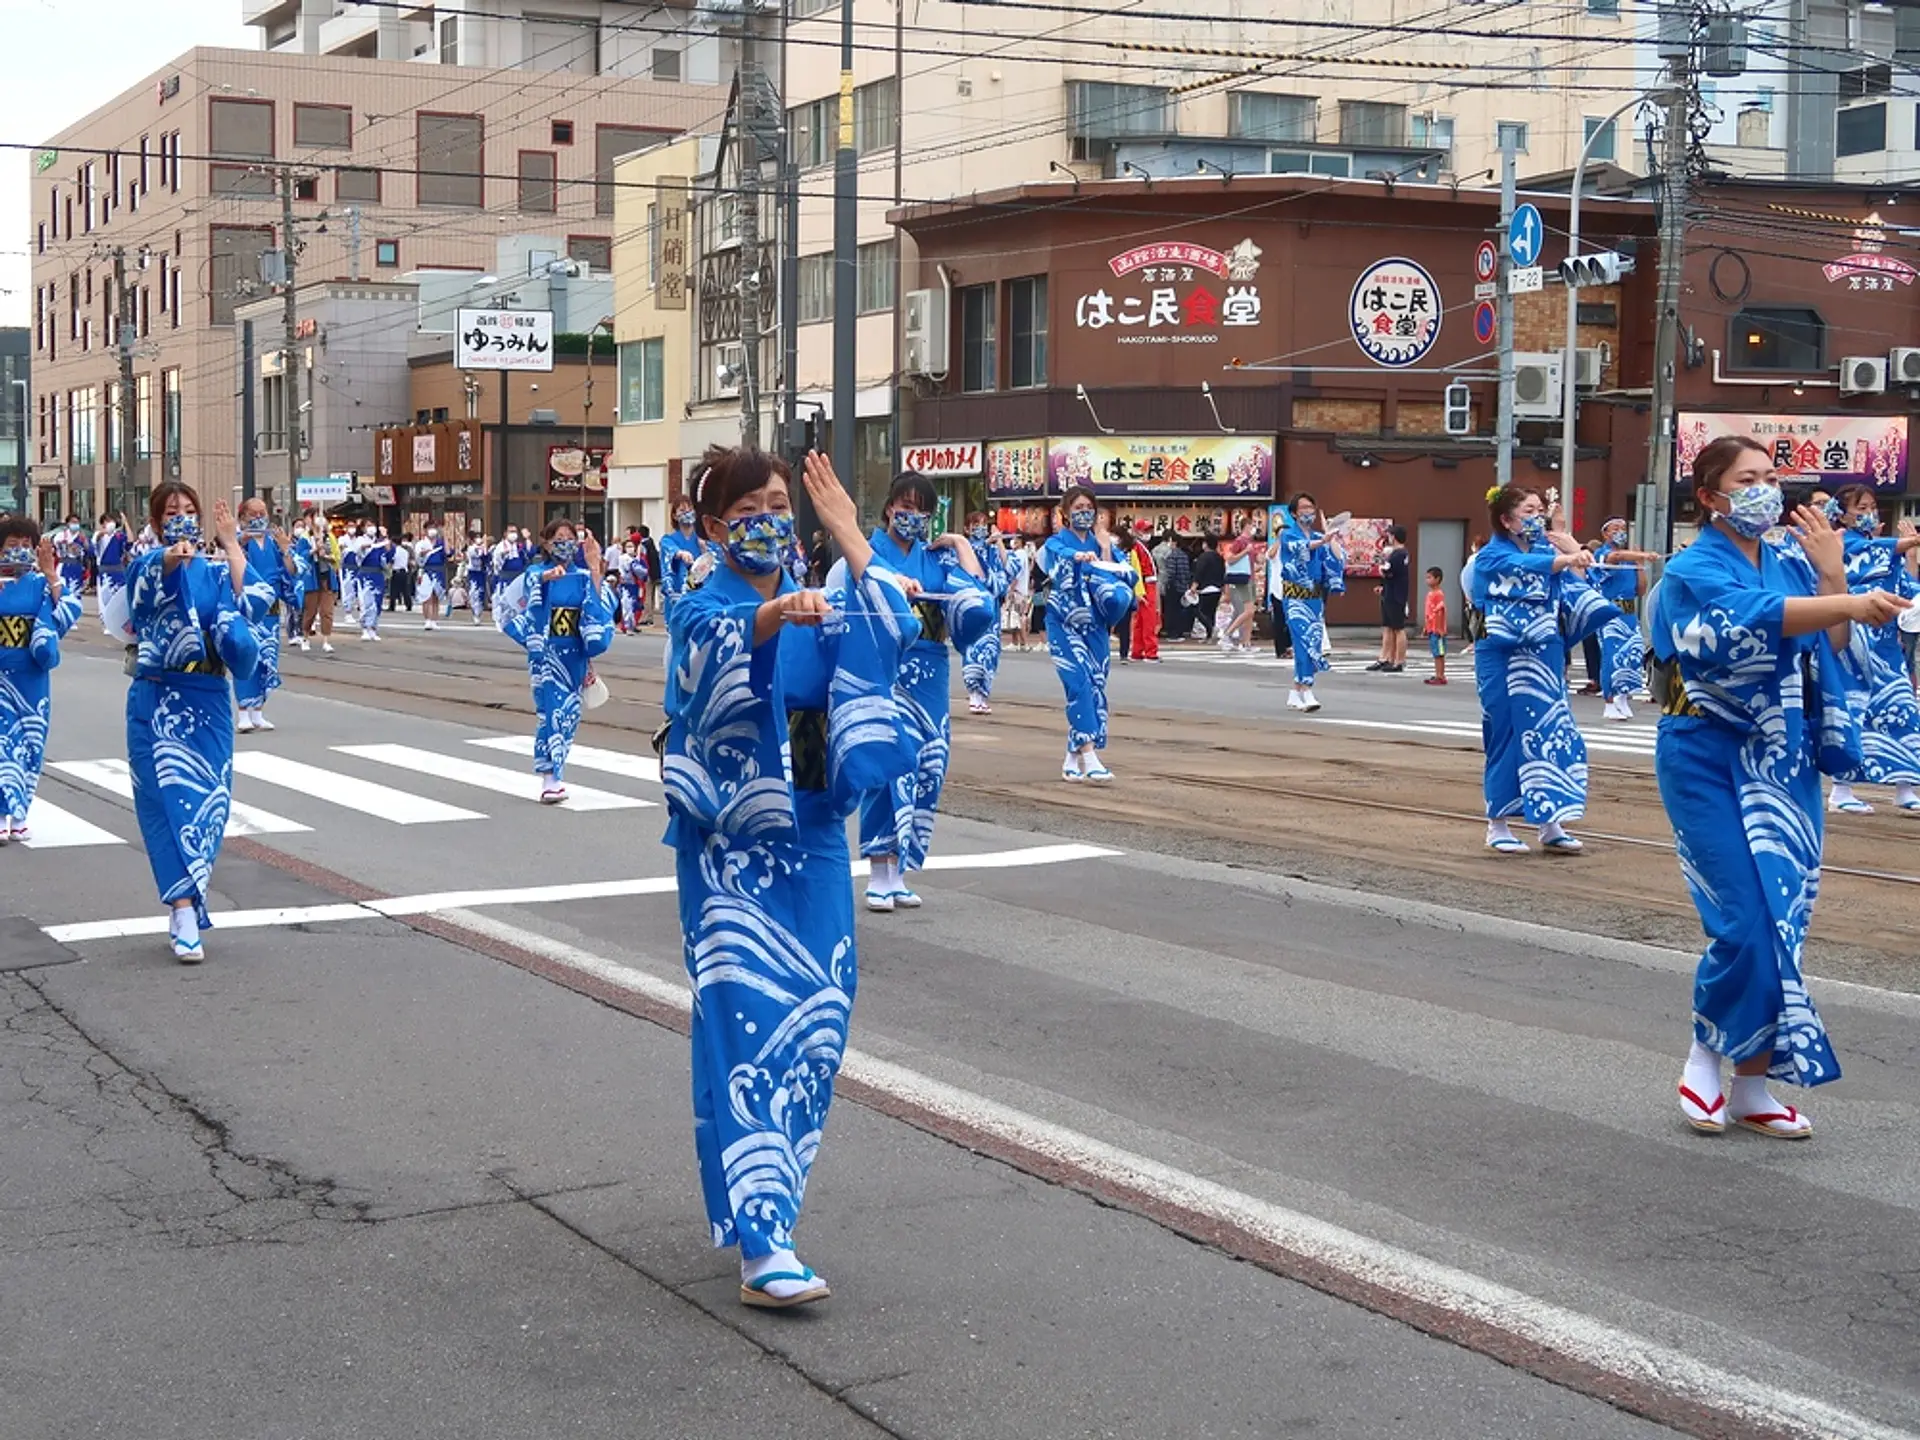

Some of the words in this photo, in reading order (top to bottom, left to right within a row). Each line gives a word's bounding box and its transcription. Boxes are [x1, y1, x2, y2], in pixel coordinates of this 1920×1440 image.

[1075, 284, 1262, 329] はこ民食堂
[1362, 286, 1429, 313] はこ民
[1372, 311, 1417, 337] 食堂
[463, 327, 549, 353] ゆうみん
[1117, 334, 1219, 344] HAKOTAMI-SHOKUDO
[906, 445, 977, 471] くすりのカメイ
[1103, 457, 1215, 482] はこ民食堂
[1118, 514, 1210, 532] は民食堂
